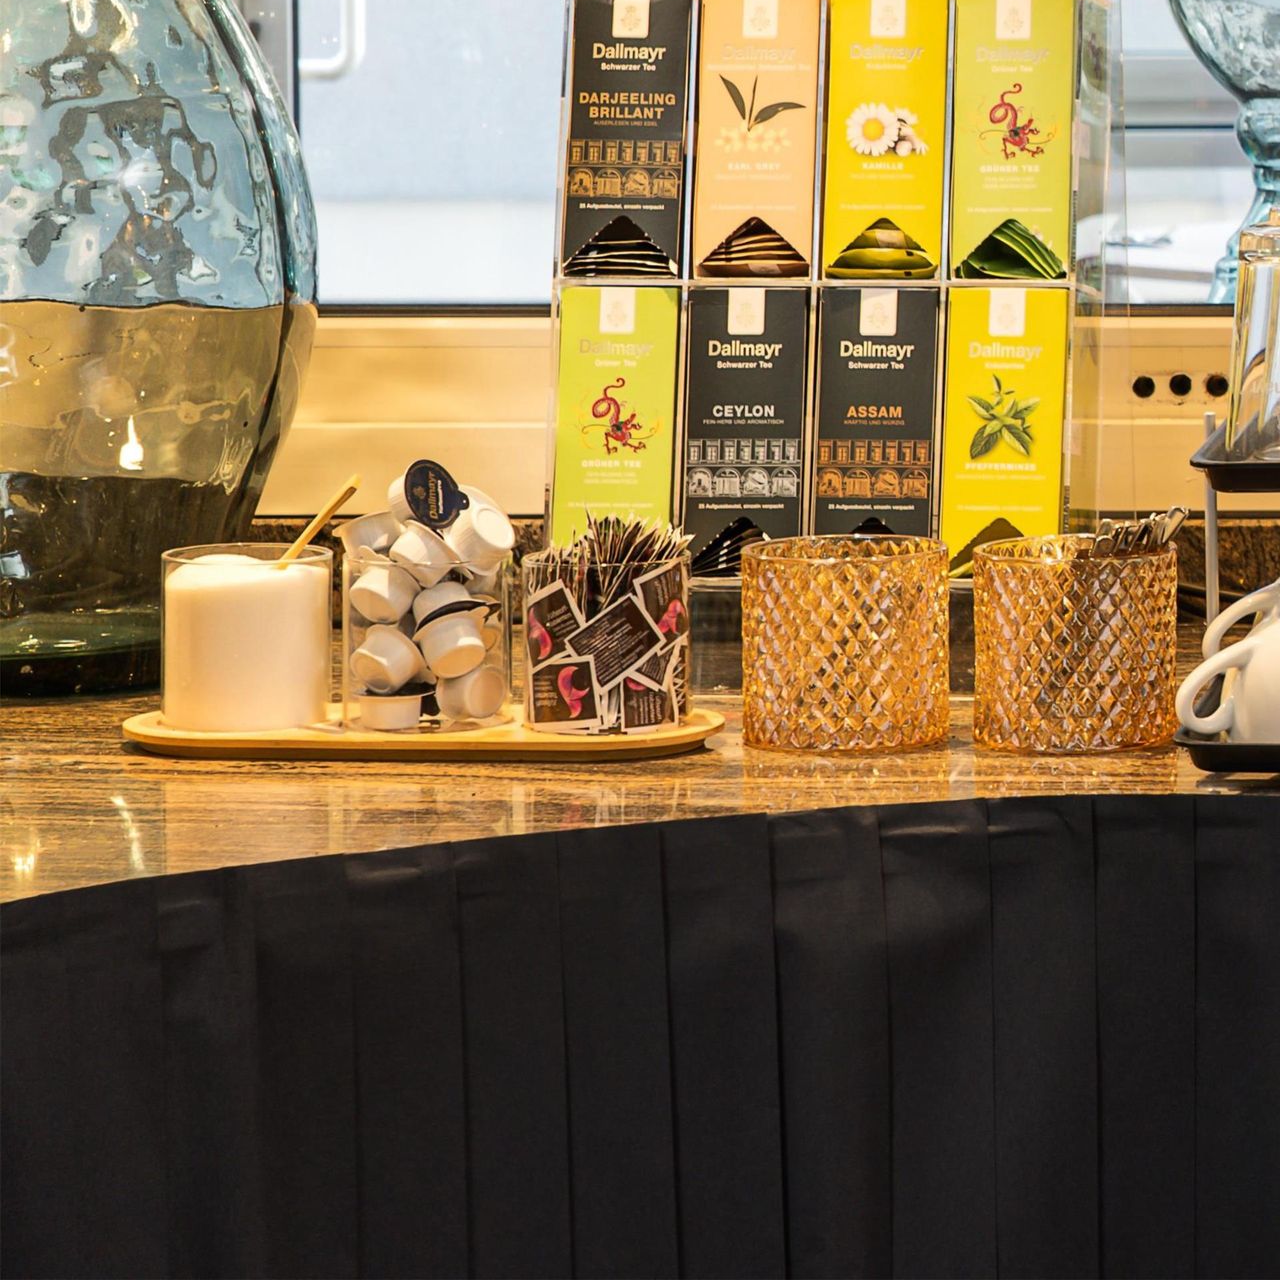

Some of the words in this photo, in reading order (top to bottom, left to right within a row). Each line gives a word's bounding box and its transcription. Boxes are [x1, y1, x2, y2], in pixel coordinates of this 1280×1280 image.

[593, 43, 666, 63] Dallmayr
[722, 45, 796, 64] Dallmayr
[850, 45, 925, 64] Dallmayr
[976, 46, 1050, 65] Dallmayr
[601, 62, 641, 71] Schwarzer
[643, 62, 656, 71] Tee
[579, 92, 676, 106] DARJEELING
[589, 107, 664, 120] BRILLANT
[862, 162, 904, 171] KAMILLE
[579, 339, 654, 358] Dallmayr
[708, 340, 782, 359] Dallmayr
[840, 340, 915, 360] Dallmayr
[968, 341, 1043, 361] Dallmayr
[716, 360, 757, 369] Schwarzer
[759, 360, 773, 369] Tee
[848, 361, 889, 370] Schwarzer
[890, 361, 905, 370] Tee
[713, 404, 774, 418] CEYLON
[847, 405, 902, 418] ASSAM
[582, 458, 620, 468] GRÜNER
[622, 460, 641, 468] TEE
[429, 472, 439, 520] Dallmayr
